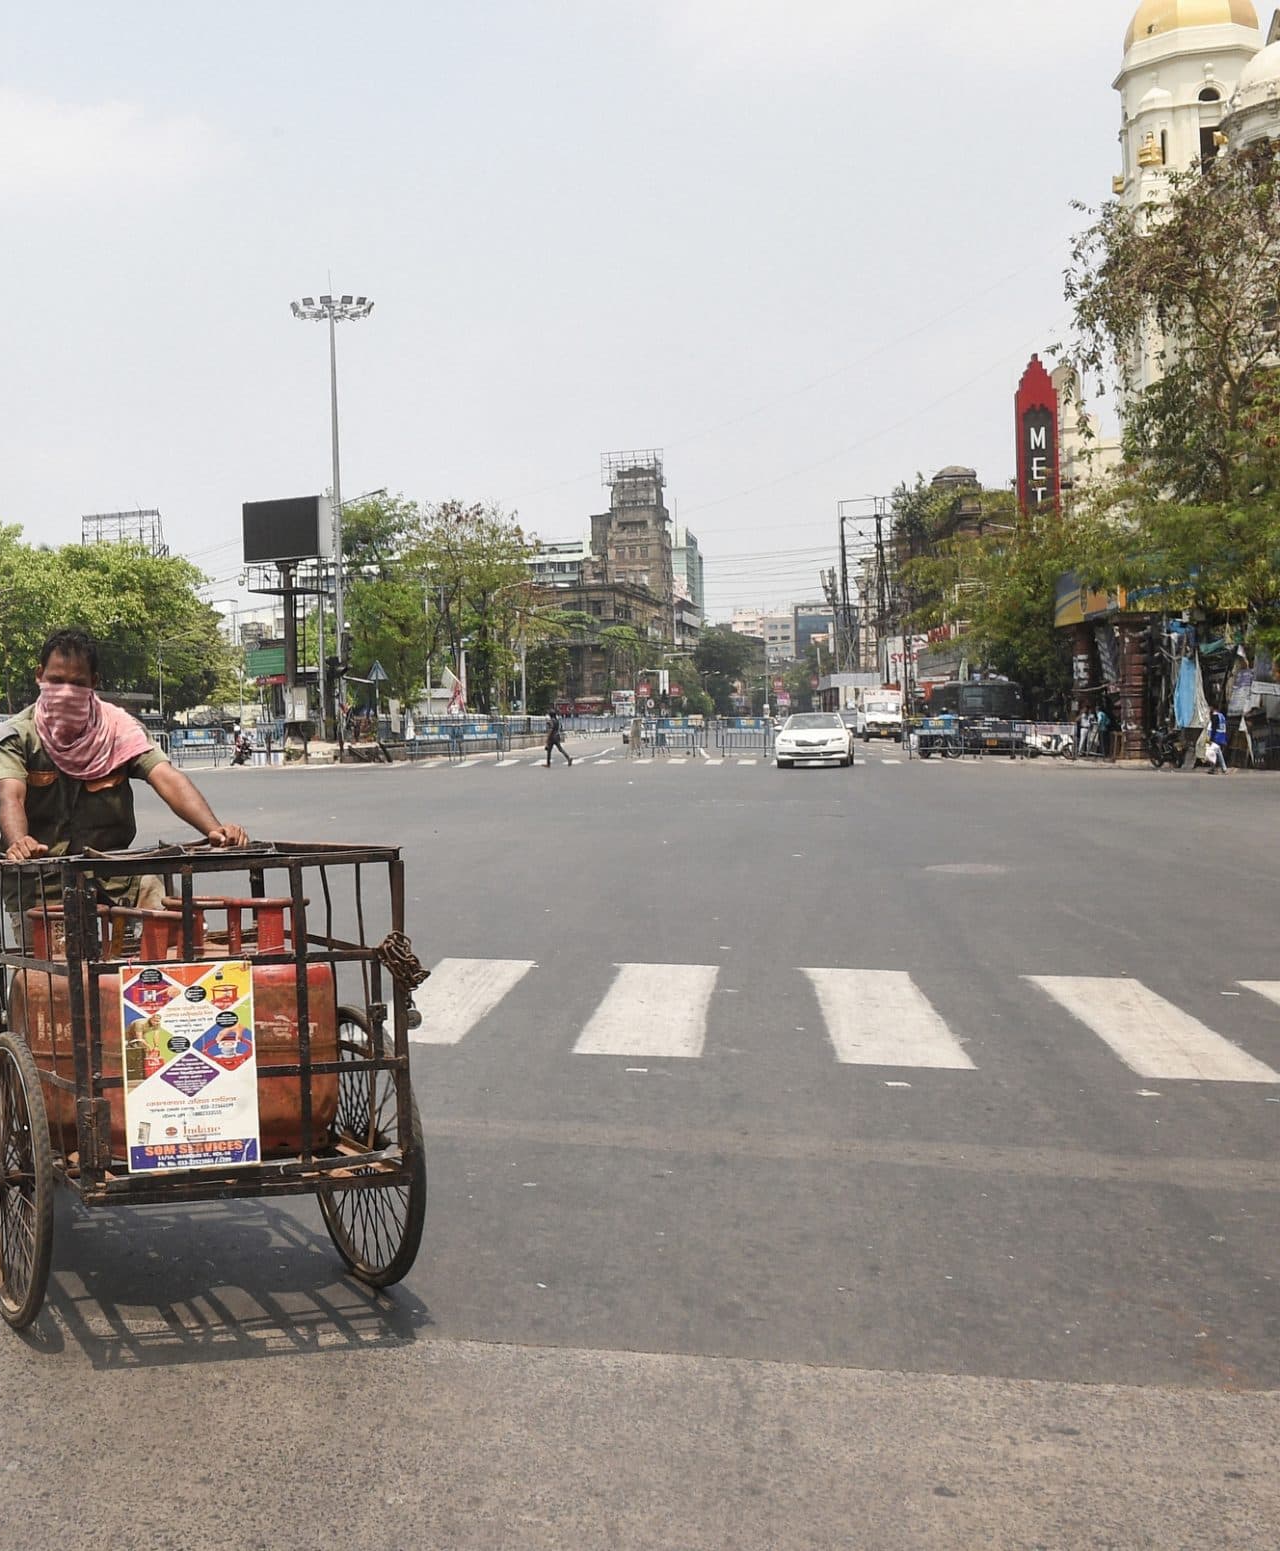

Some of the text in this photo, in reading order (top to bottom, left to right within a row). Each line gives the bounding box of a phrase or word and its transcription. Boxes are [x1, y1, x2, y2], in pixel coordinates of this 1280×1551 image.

[1030, 426, 1047, 506] MET
[144, 1140, 243, 1157] SOM SERVICES
